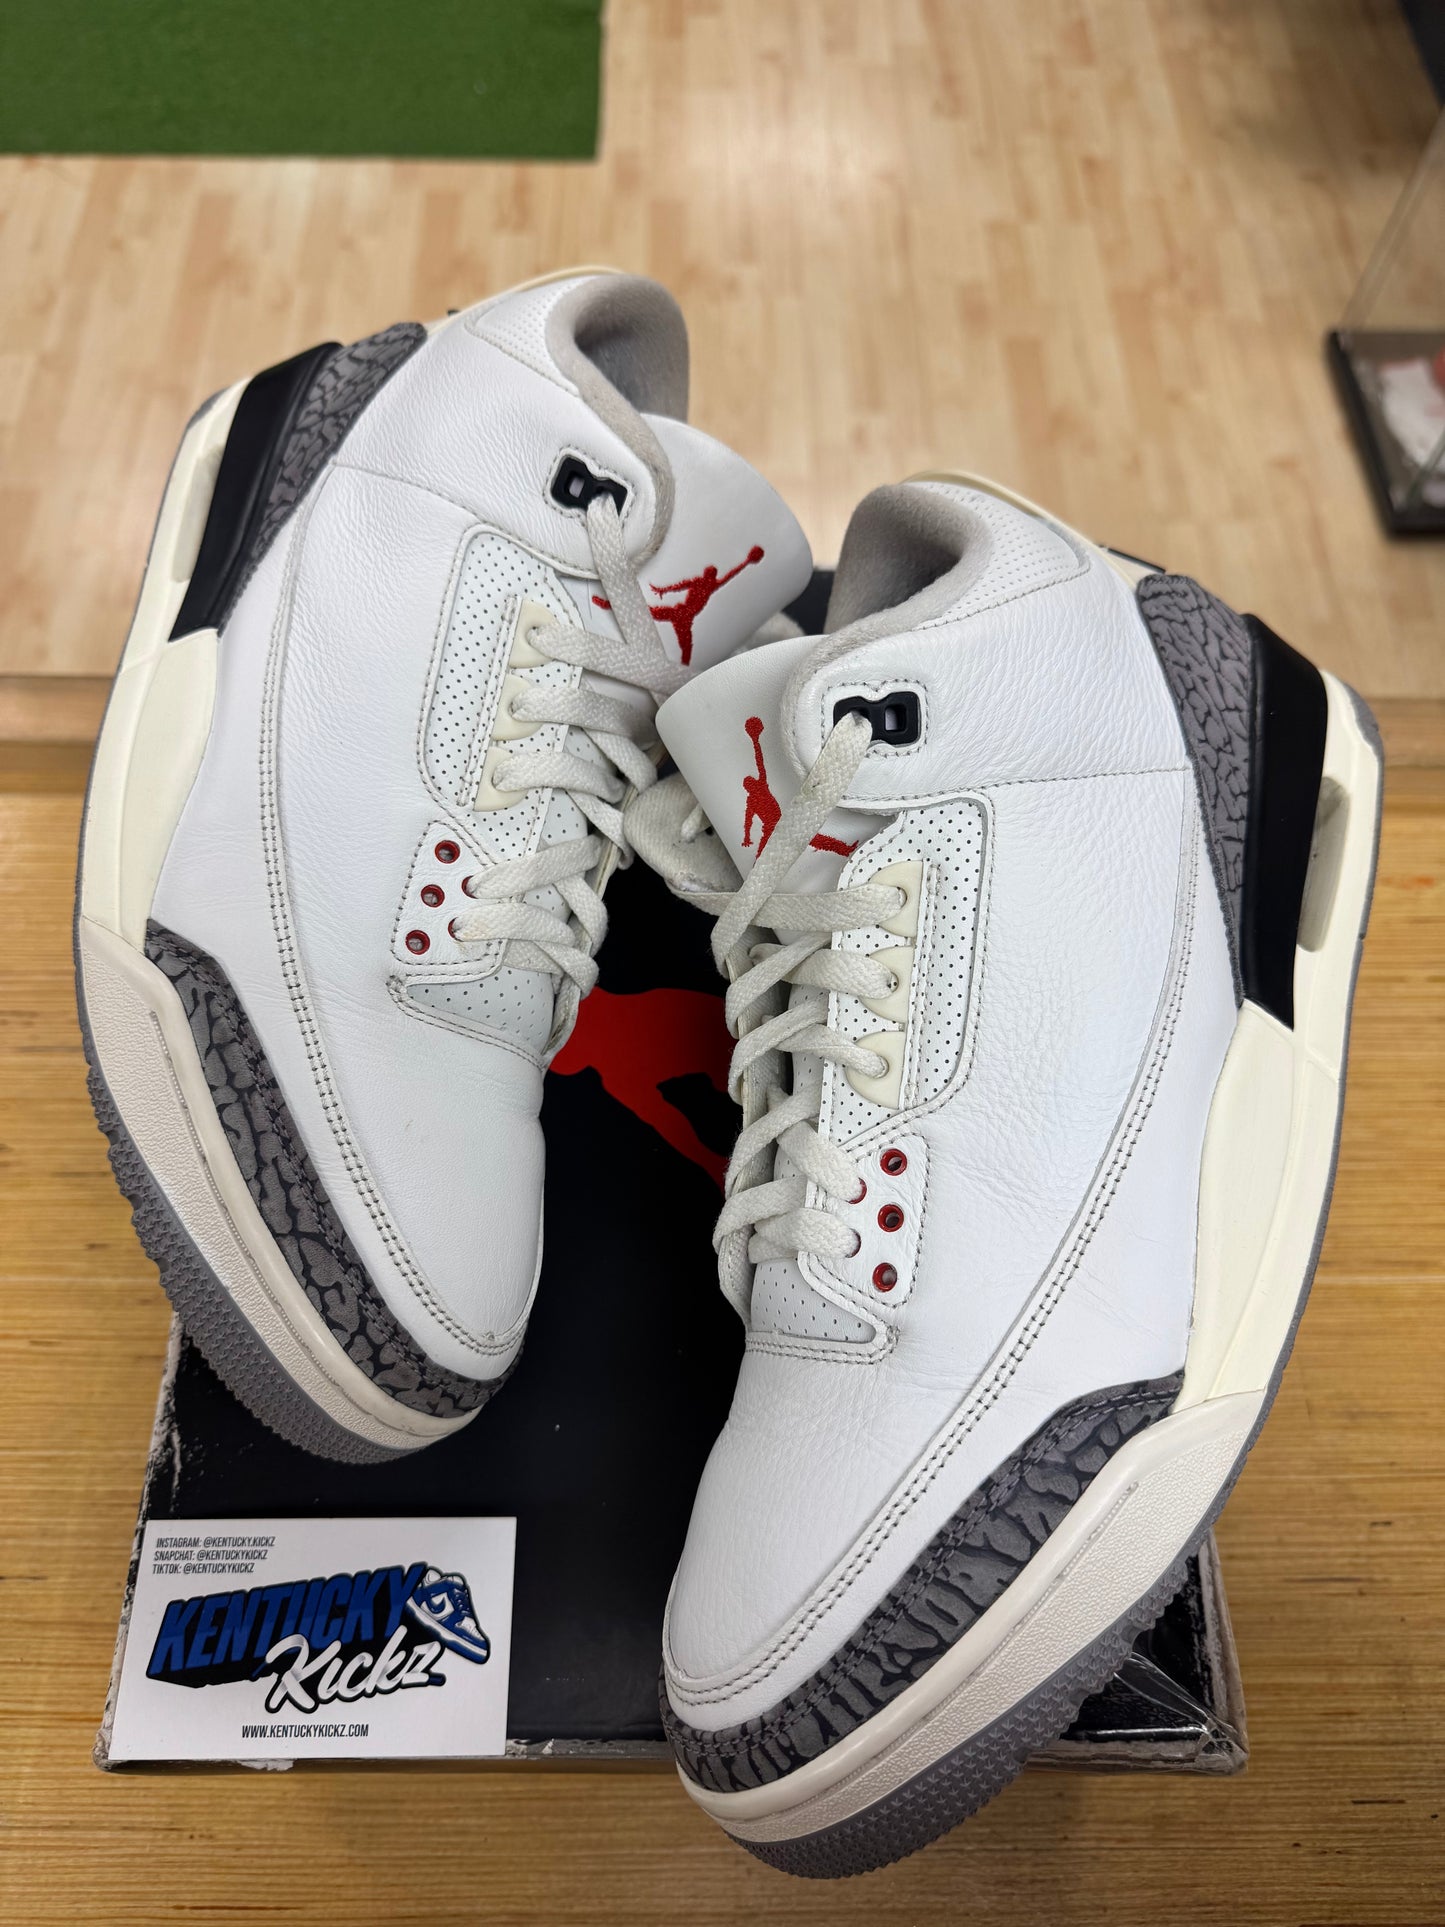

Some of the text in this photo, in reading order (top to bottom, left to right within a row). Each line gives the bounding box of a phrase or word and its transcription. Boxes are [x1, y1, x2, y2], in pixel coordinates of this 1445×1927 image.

[156, 1536, 276, 1548] INSTAGRAM: @KENTUCKY.KICKZ
[154, 1549, 269, 1561] SNAPCHAT: @KENTUCKYKICKZ
[152, 1562, 256, 1574] TIKTOK: @KENTUCKYKICKZ
[147, 1562, 428, 1681] KENTUCKY
[241, 1723, 369, 1738] WWW.KENTUCKYKICKZ.COM
